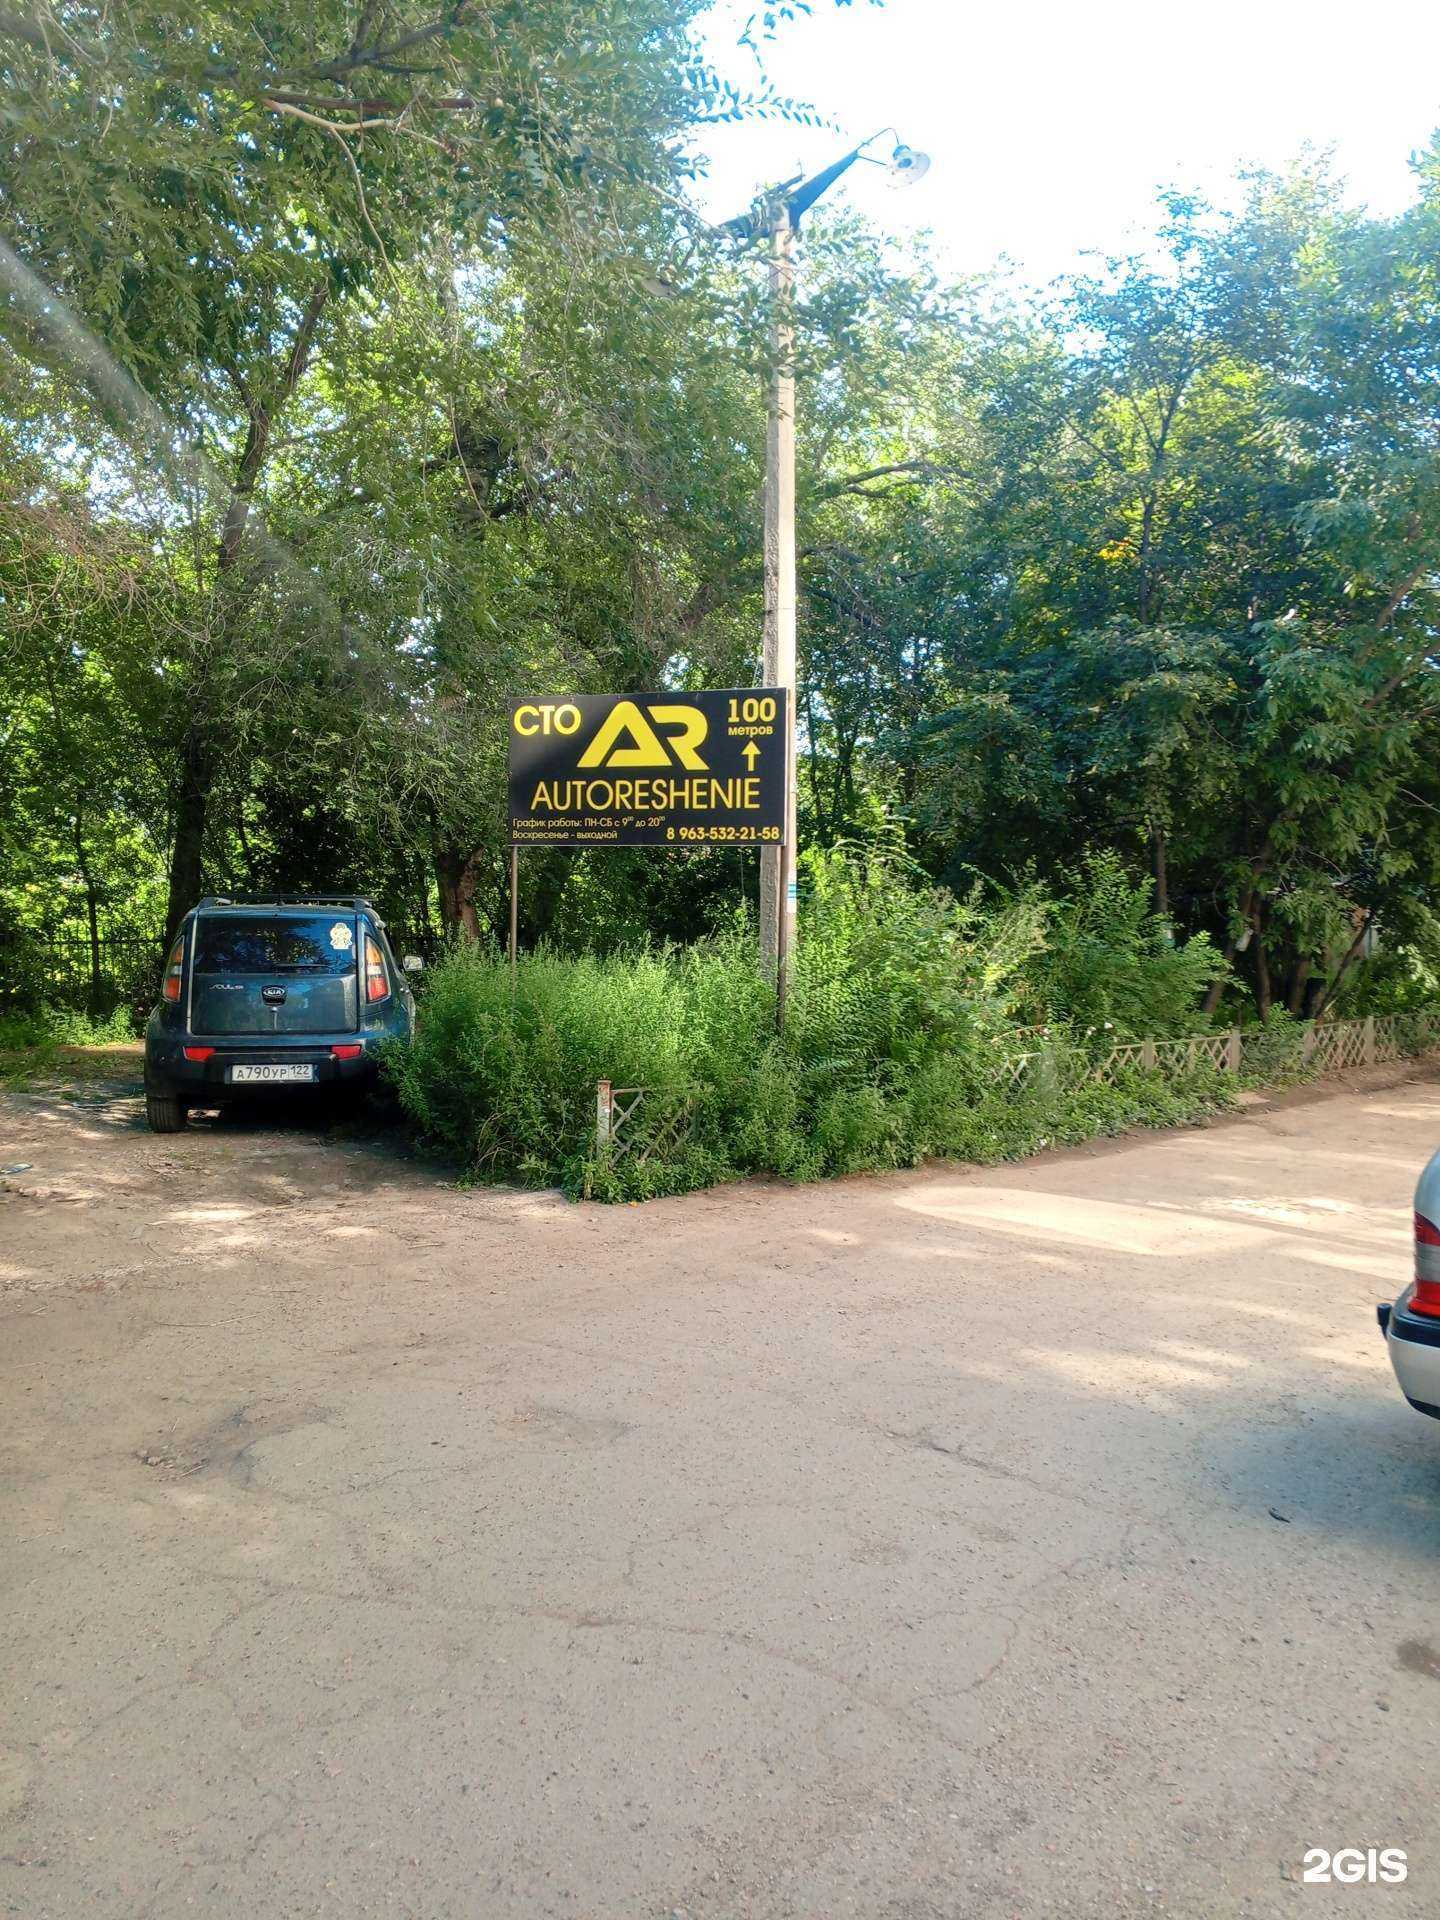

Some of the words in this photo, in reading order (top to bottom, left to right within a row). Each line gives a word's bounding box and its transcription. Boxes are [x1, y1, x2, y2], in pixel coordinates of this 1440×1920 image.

[728, 697, 777, 723] 100
[513, 704, 581, 736] СТО
[576, 700, 710, 771] AR
[728, 725, 774, 738] метров
[530, 777, 761, 811] AUTORESHENIE
[512, 818, 546, 828] График
[547, 817, 582, 829] работы:
[512, 830, 569, 840] Воскресенье
[576, 830, 618, 840] выходной
[666, 827, 675, 840] 8
[679, 826, 780, 840] 963-532-21-58
[290, 1065, 310, 1075] 122
